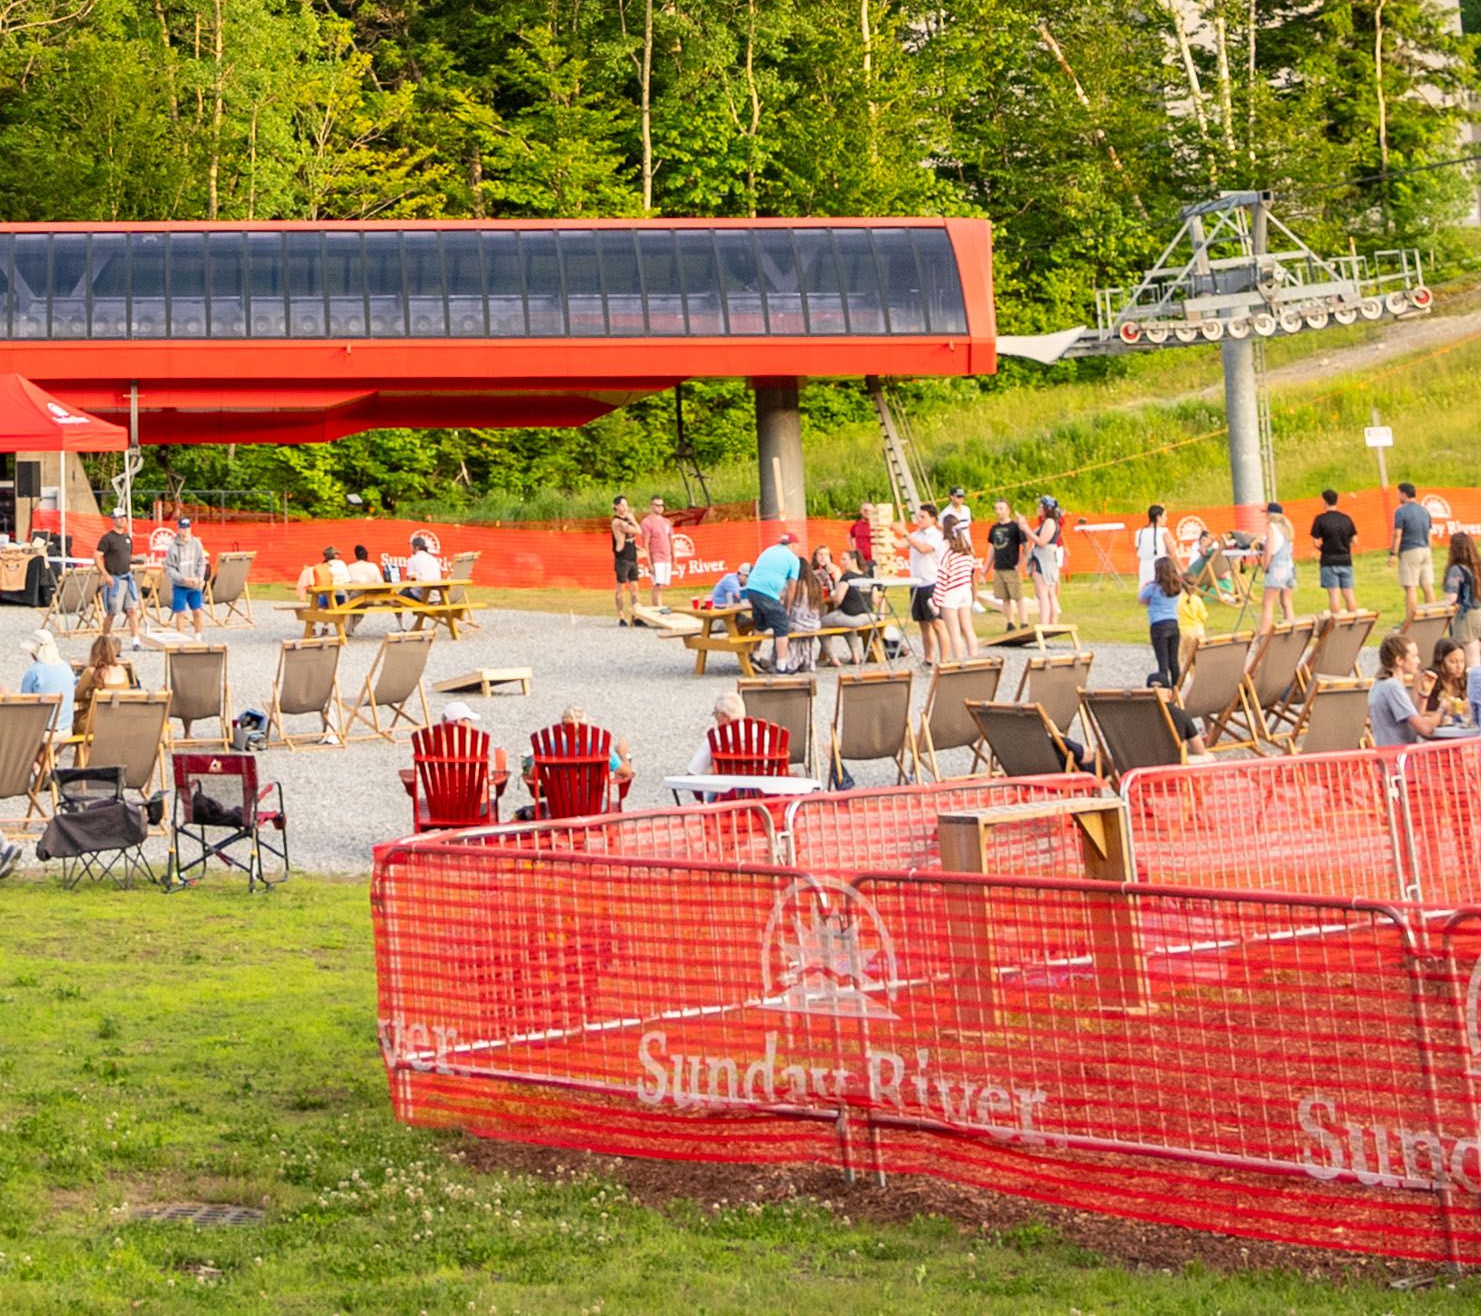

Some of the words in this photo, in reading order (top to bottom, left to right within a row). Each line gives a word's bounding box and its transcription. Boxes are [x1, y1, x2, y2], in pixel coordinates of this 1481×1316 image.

[688, 558, 725, 574] River
[378, 1019, 458, 1075] ver
[637, 1030, 860, 1109] Sunday
[866, 1047, 1047, 1148] River
